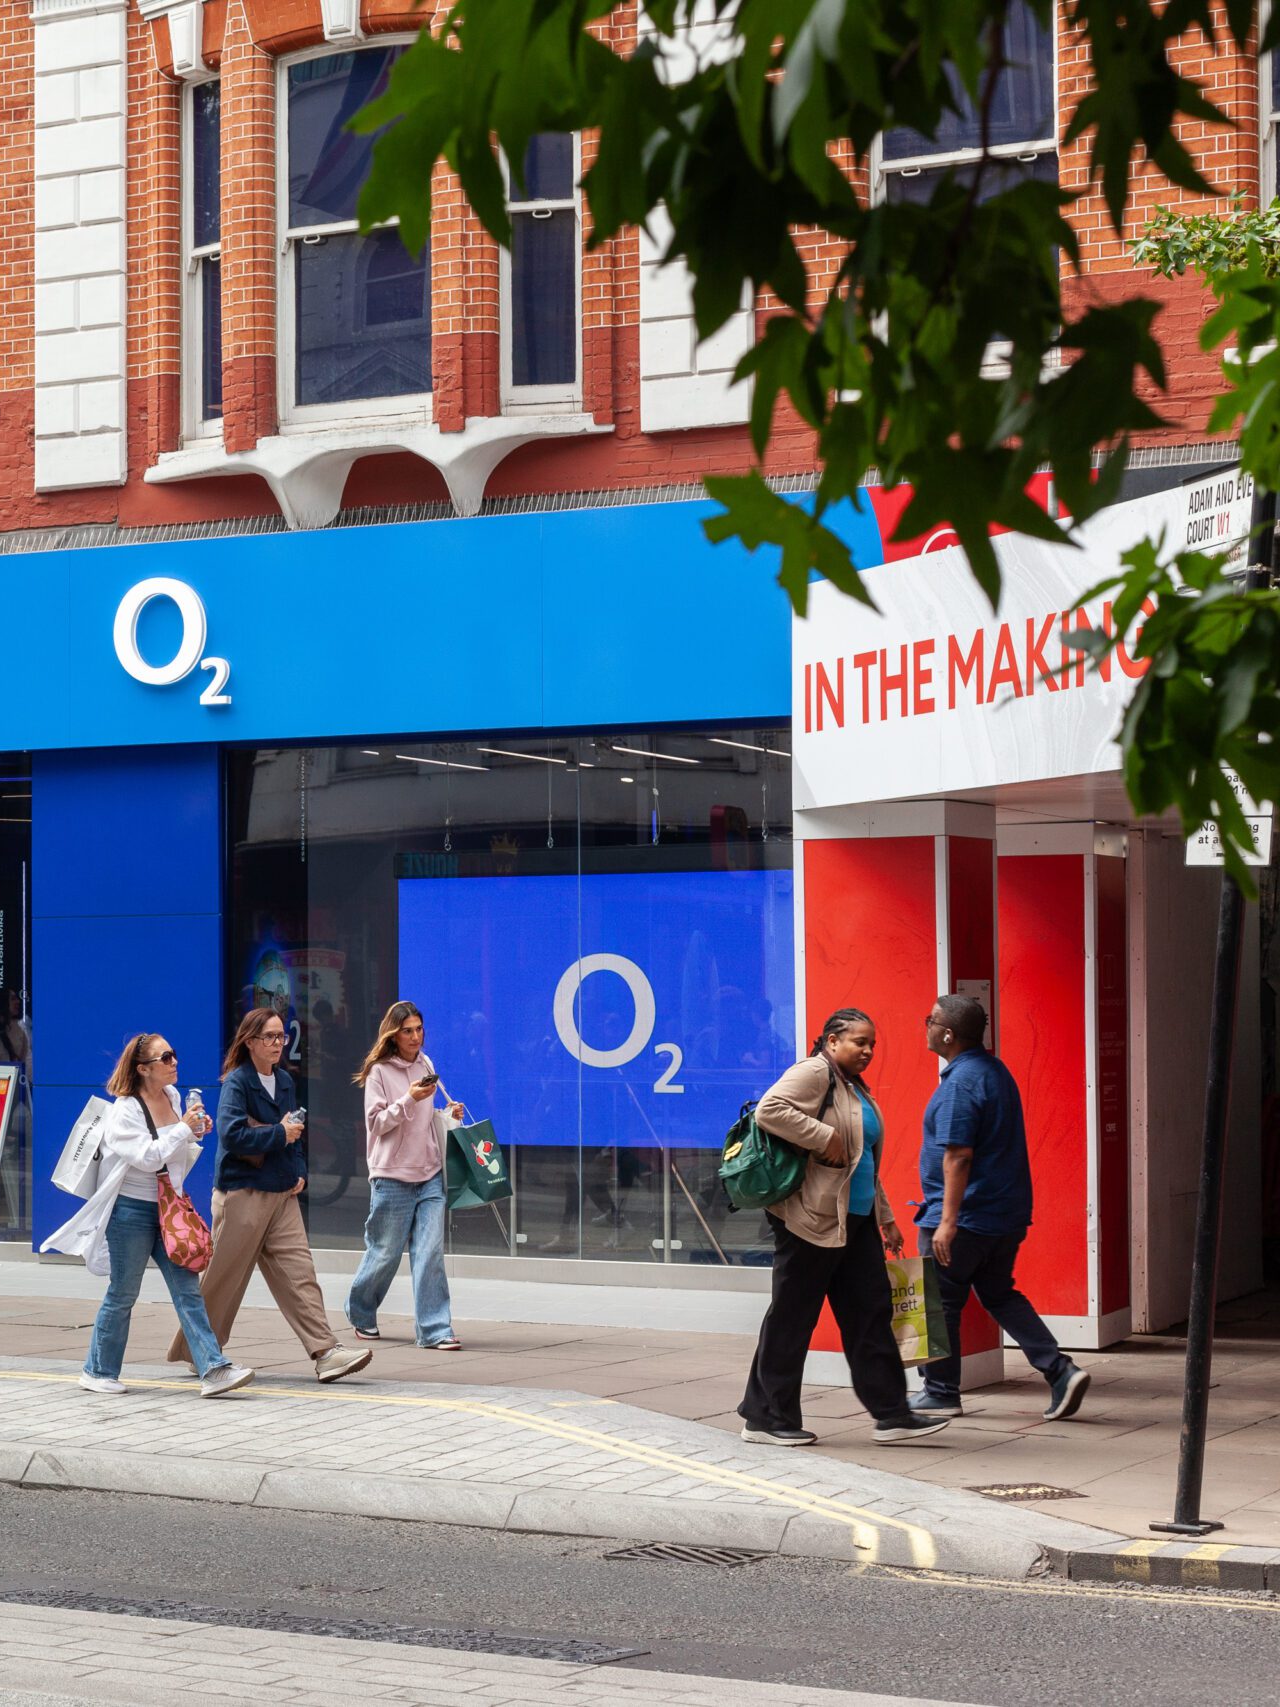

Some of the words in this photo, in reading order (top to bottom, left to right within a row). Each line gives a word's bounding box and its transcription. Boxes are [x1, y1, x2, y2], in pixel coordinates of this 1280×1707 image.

[1186, 516, 1215, 545] COURT
[1216, 511, 1231, 536] W1
[1188, 486, 1213, 515] ADAM
[1215, 480, 1233, 506] AND
[1236, 473, 1252, 500] EVE
[113, 576, 232, 705] O2
[804, 657, 845, 734] IN
[853, 638, 936, 725] THE
[1198, 834, 1209, 845] at
[553, 953, 685, 1094] O2
